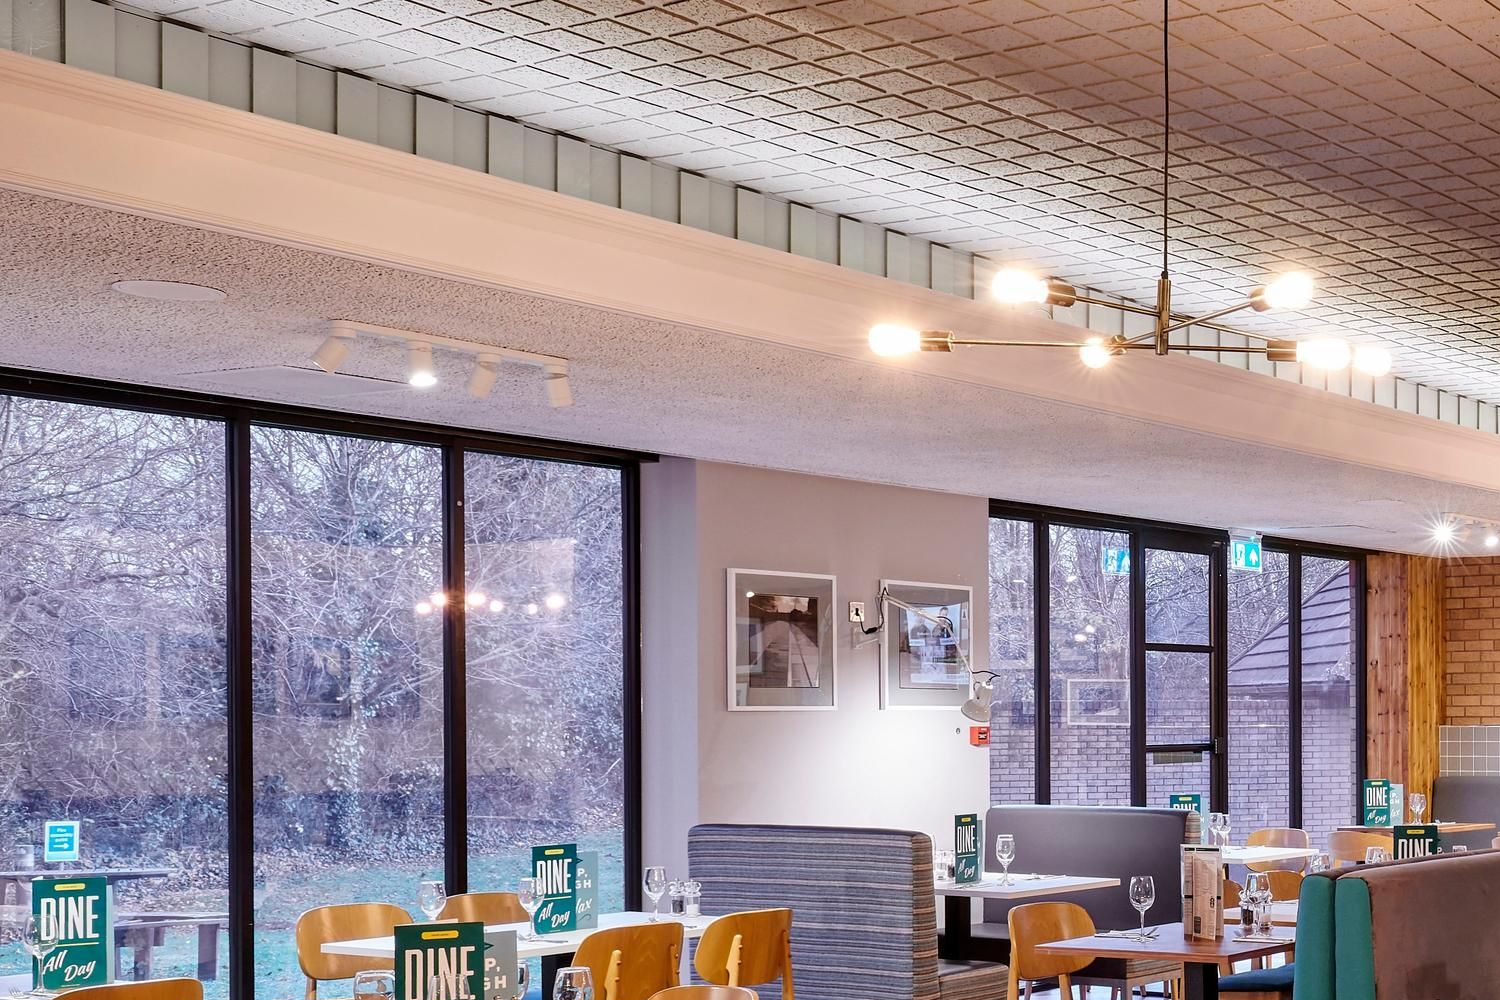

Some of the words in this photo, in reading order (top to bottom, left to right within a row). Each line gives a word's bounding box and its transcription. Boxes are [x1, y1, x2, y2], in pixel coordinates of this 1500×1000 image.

[1366, 787, 1388, 807] DINE
[957, 825, 976, 853] DINE
[536, 858, 572, 895] DINE
[40, 896, 99, 941] DINE
[538, 902, 554, 922] All
[551, 911, 571, 928] Day
[42, 950, 68, 975] All
[64, 961, 96, 982] Day
